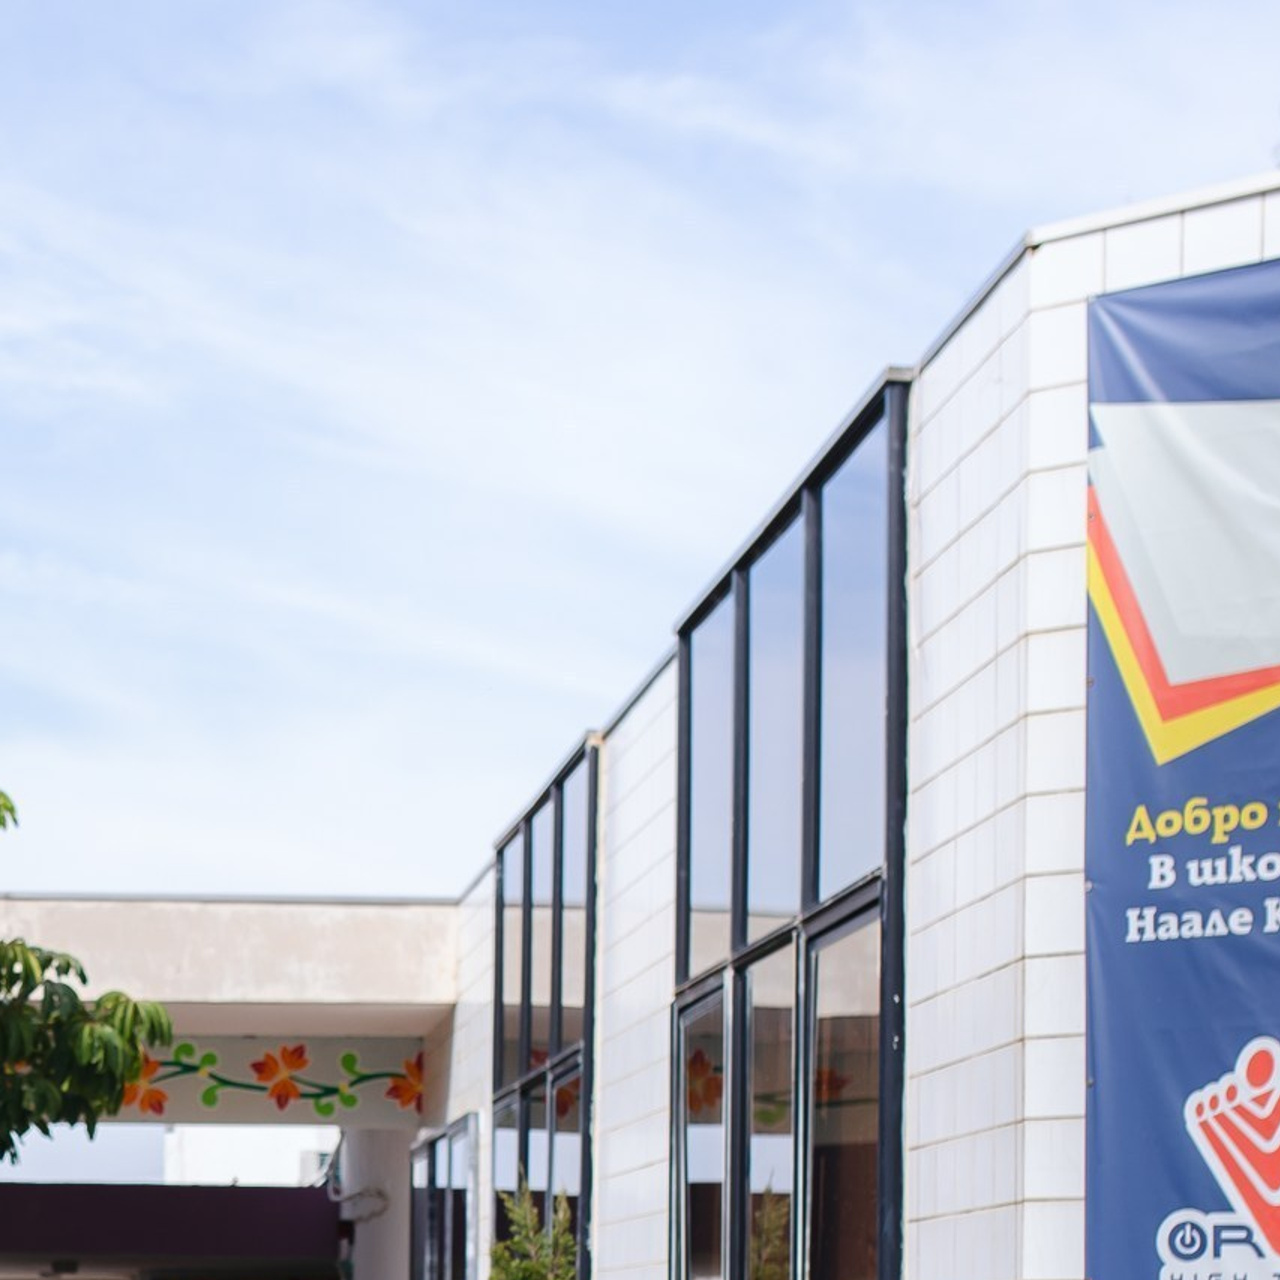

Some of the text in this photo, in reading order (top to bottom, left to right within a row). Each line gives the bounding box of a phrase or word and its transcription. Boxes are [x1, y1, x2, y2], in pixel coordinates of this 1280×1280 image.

[1126, 796, 1268, 846] Добро
[1148, 854, 1177, 890] В
[1125, 905, 1253, 943] Наале
[1168, 1220, 1266, 1261] OR
